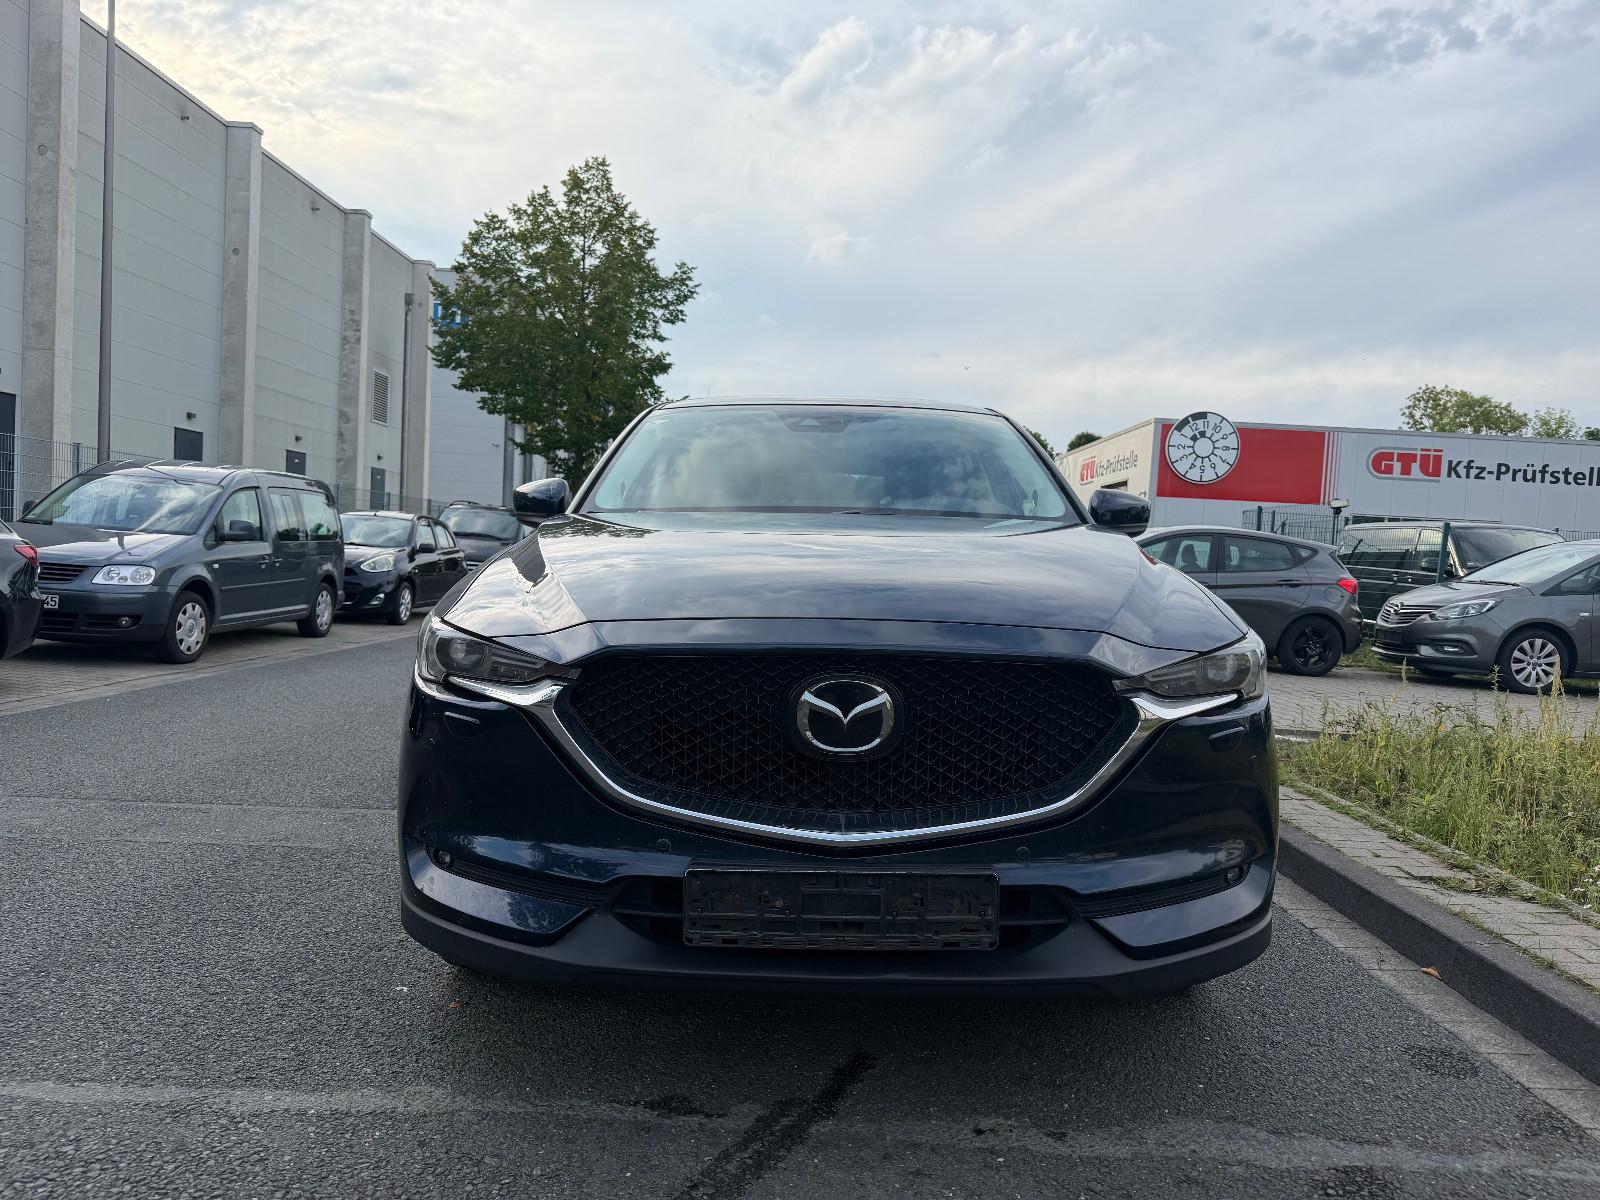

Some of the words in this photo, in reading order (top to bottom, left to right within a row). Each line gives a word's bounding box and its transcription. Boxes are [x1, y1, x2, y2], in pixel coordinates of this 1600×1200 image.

[1189, 422, 1200, 432] 12
[1202, 420, 1209, 429] 11
[1212, 423, 1222, 433] 10
[1080, 456, 1096, 482] GTÜ
[1095, 450, 1138, 477] Kfz-Prüfstelle
[1200, 465, 1205, 473] 5
[1210, 463, 1216, 471] 6
[1372, 448, 1443, 477] GTÜ
[1447, 460, 1600, 487] Kfz-Prüfstell
